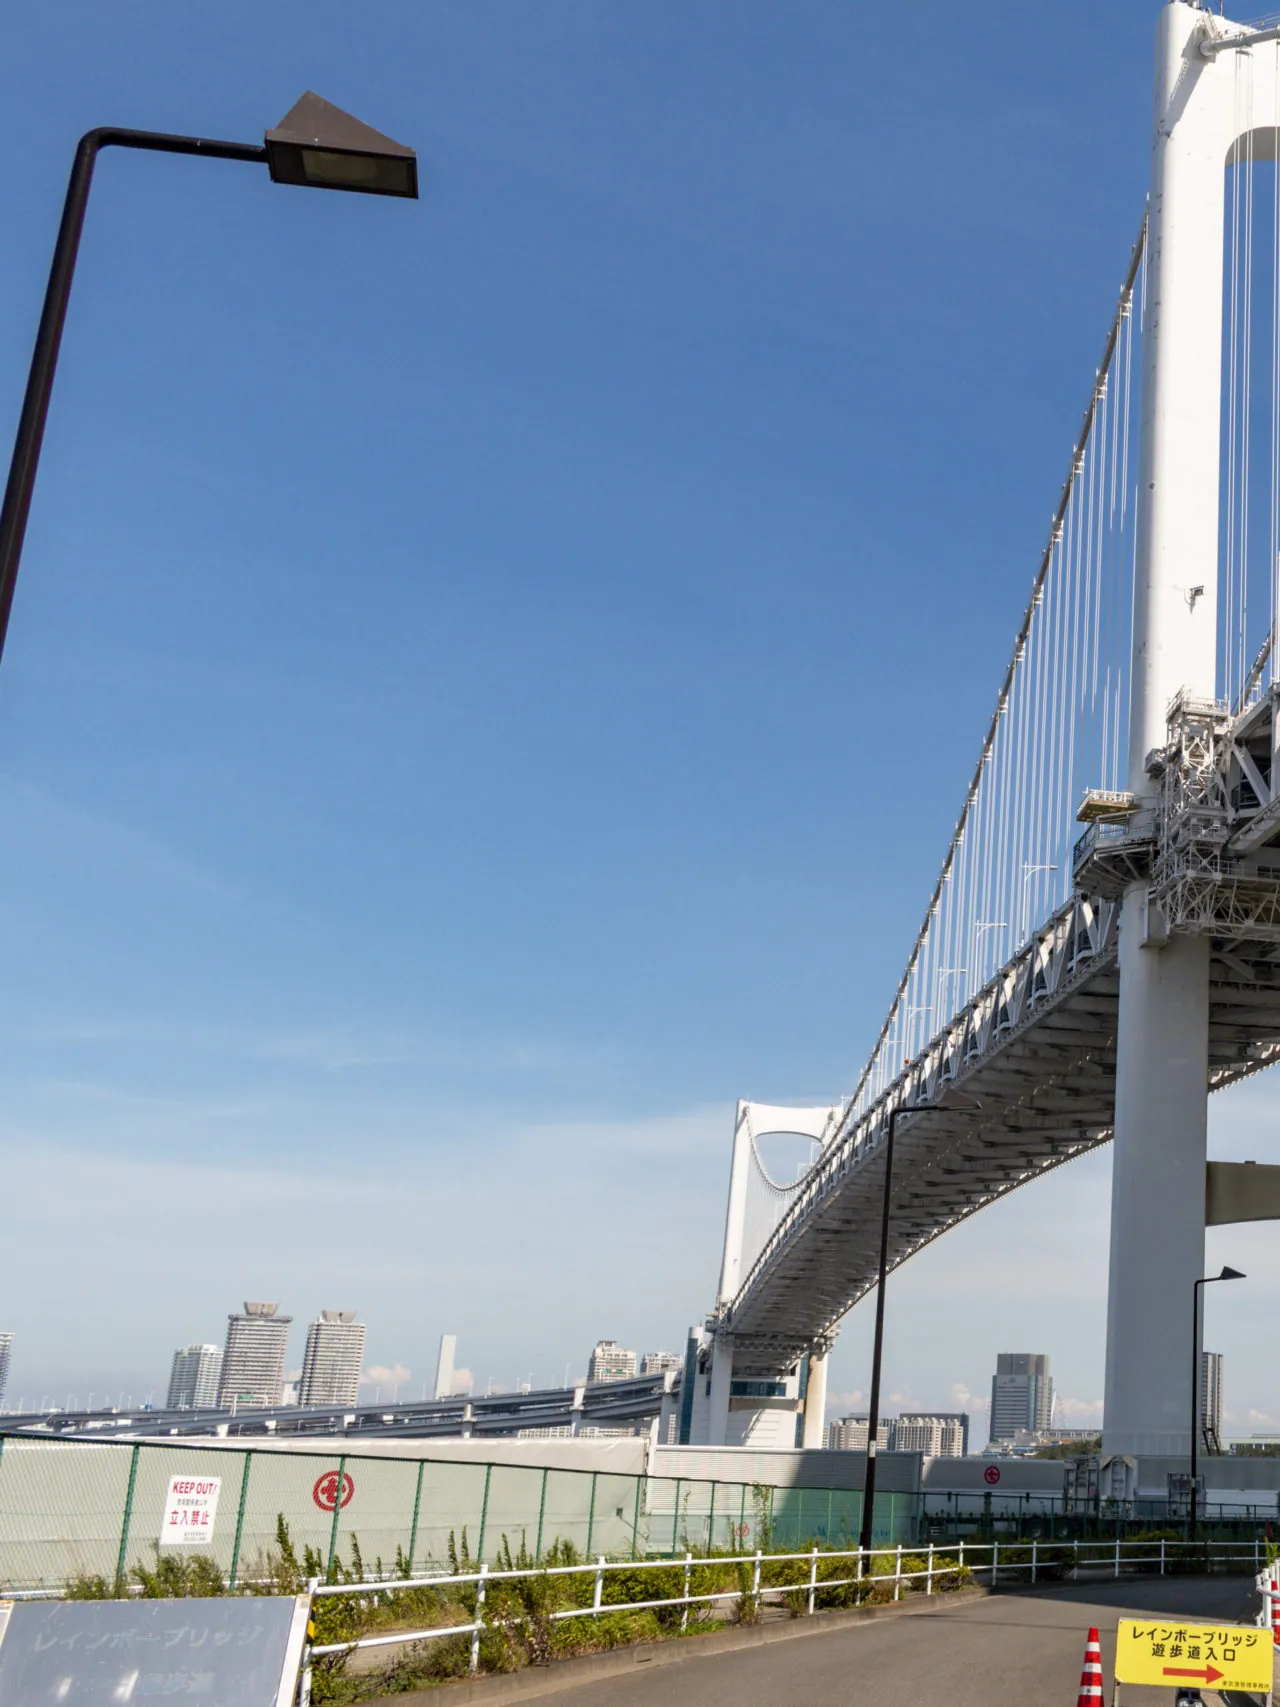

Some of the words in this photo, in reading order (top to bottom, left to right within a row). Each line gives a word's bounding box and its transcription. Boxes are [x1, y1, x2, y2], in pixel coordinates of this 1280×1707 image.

[172, 1481, 196, 1494] KEEP
[196, 1482, 217, 1495] OUT!
[169, 1510, 210, 1526] 立入禁止
[1132, 1626, 1258, 1648] レインボーブリッジ
[1151, 1643, 1236, 1662] 遊歩道入口
